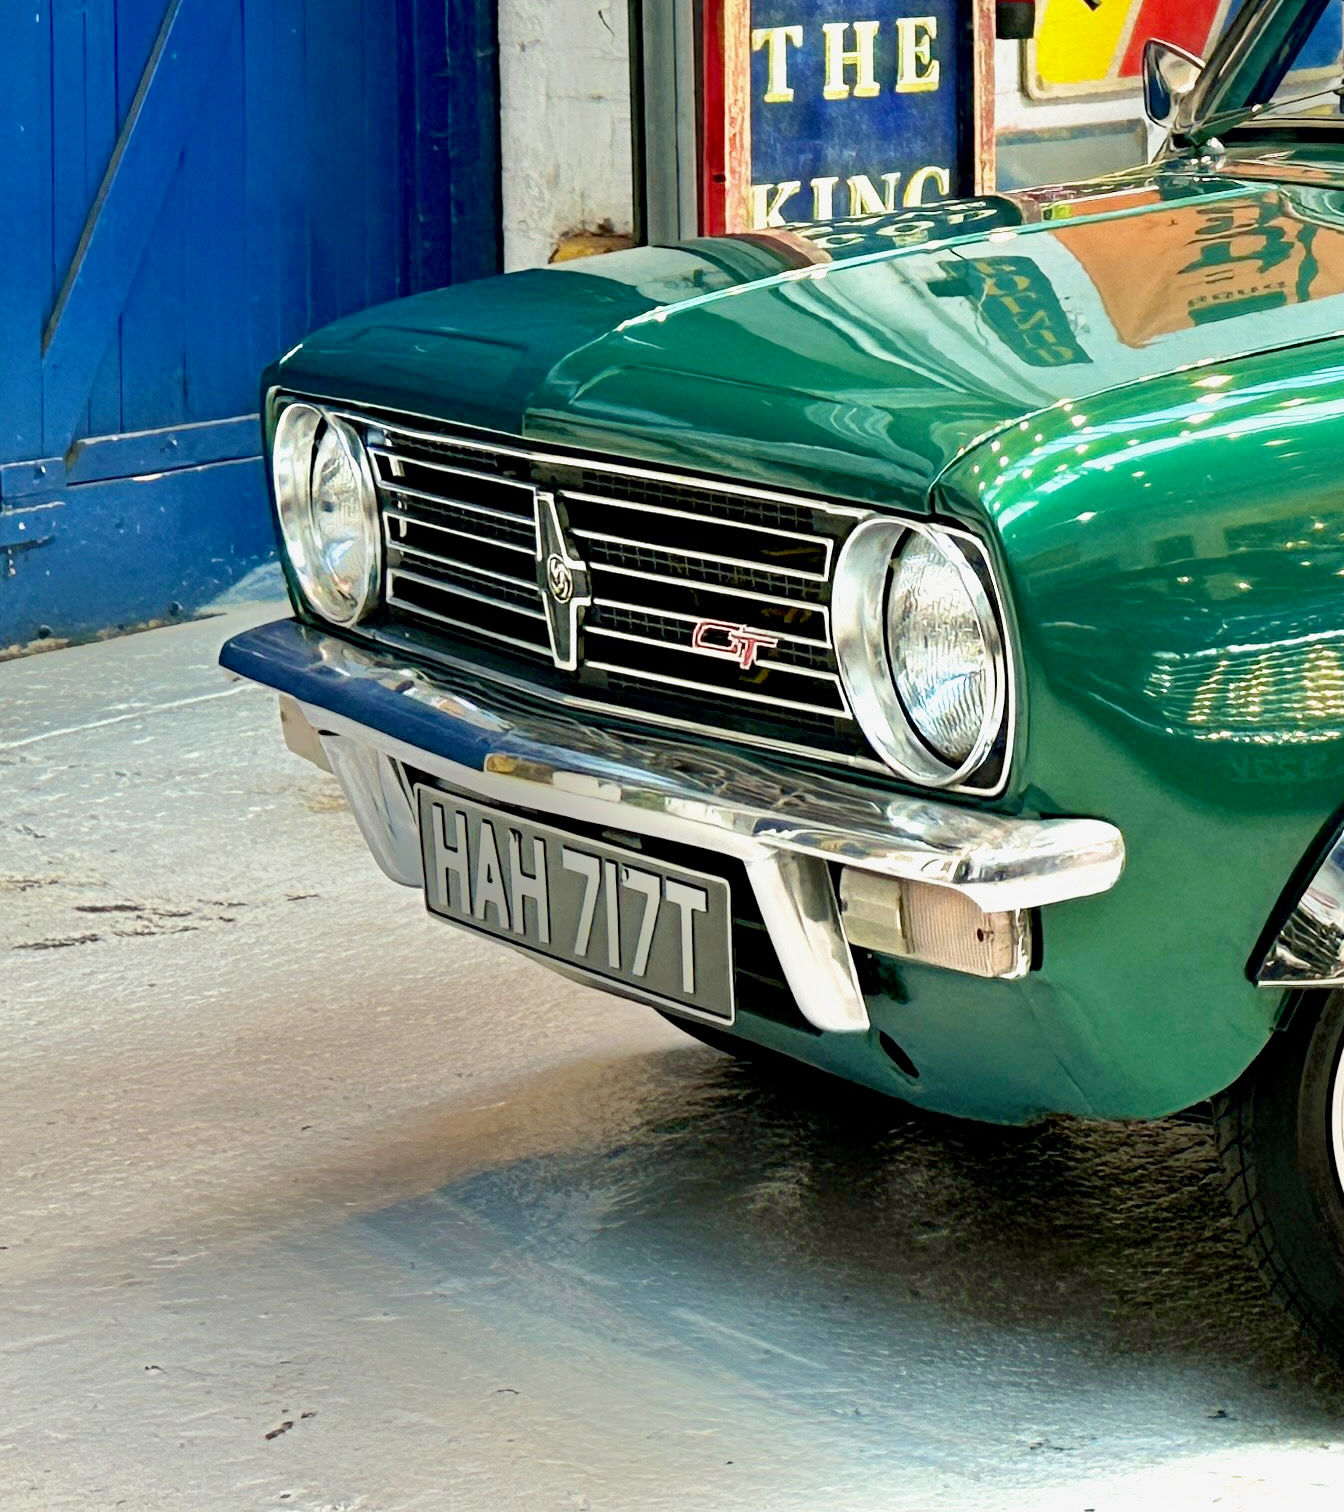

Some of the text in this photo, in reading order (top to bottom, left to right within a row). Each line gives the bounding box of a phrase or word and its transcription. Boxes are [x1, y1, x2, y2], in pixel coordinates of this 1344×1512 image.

[751, 15, 940, 104] THE
[692, 619, 777, 670] GT
[432, 799, 708, 996] HAH 717T
